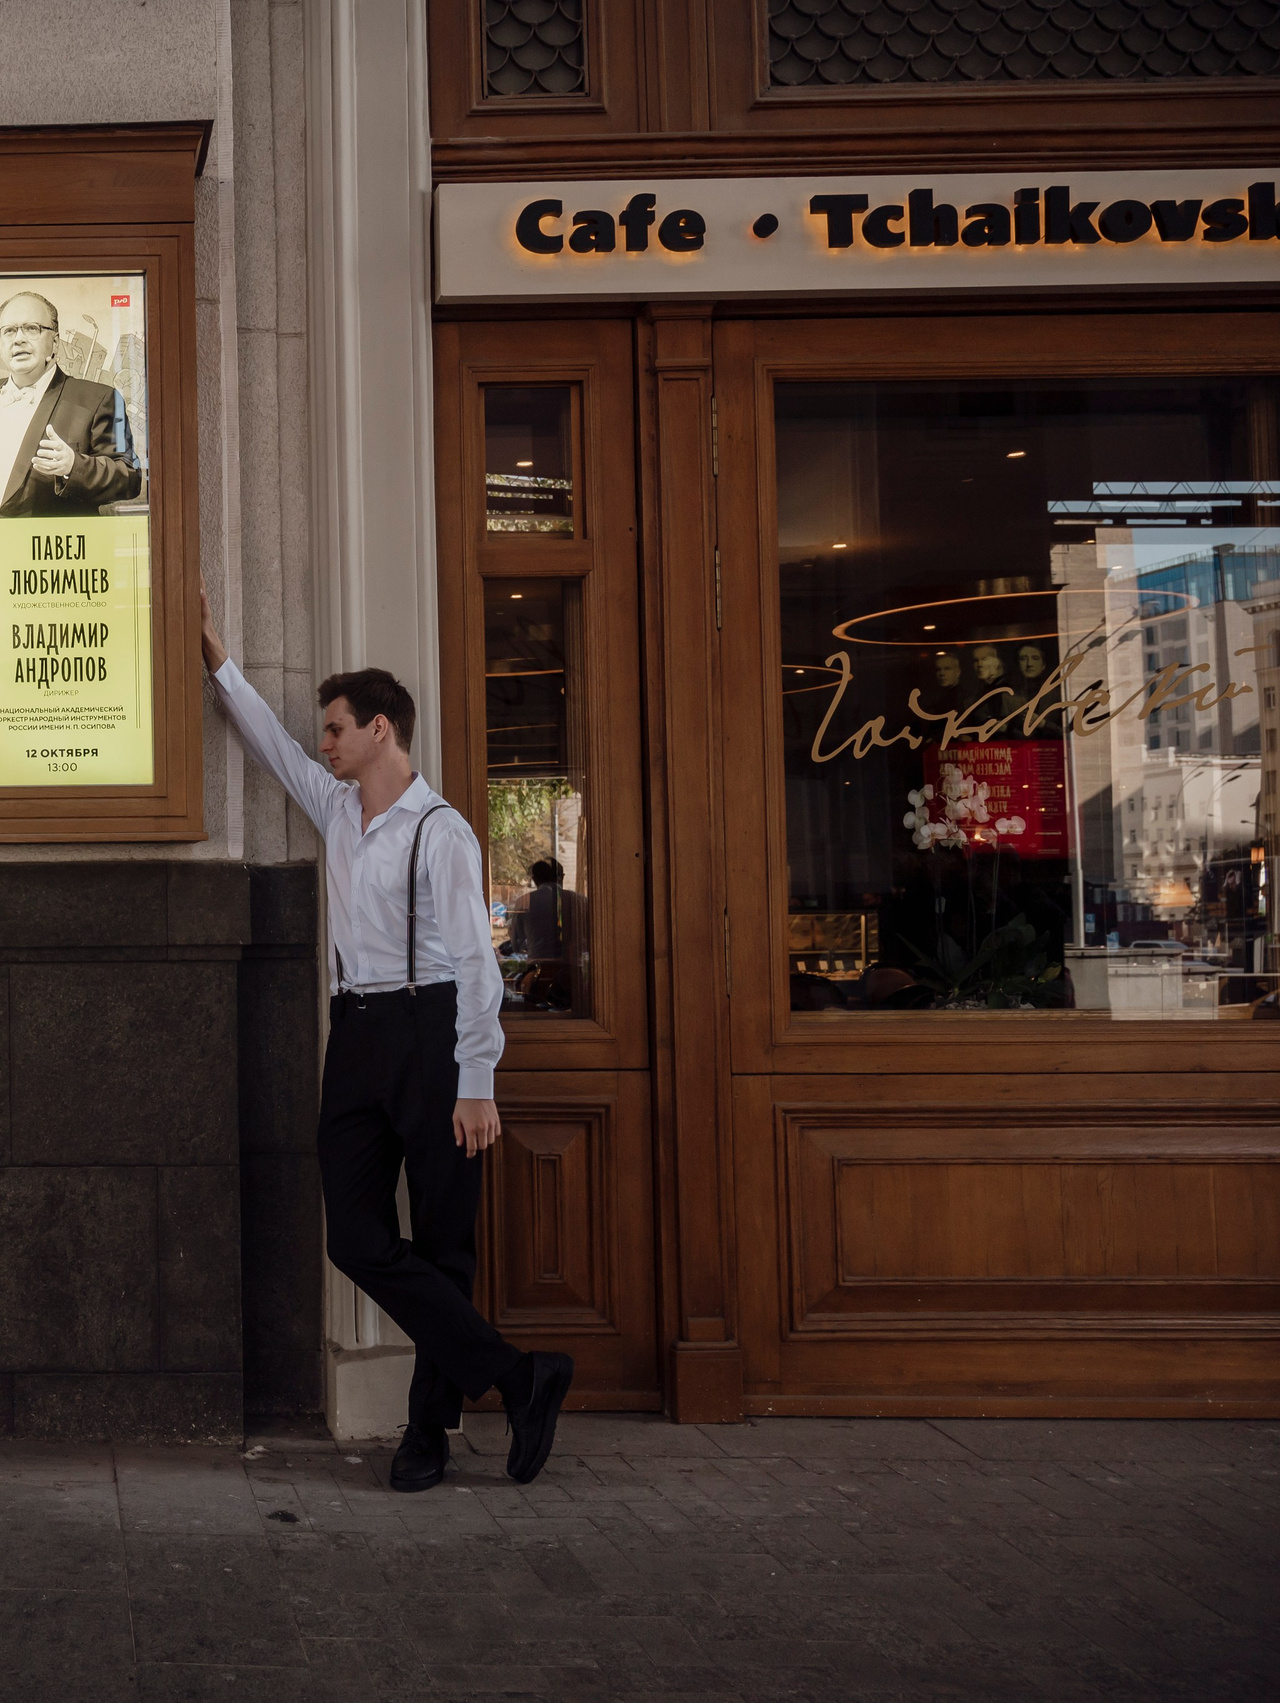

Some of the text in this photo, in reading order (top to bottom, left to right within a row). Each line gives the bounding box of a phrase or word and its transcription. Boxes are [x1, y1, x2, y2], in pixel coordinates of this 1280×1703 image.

[515, 193, 706, 254] Cafe
[32, 535, 86, 560] ПАВЕЛ
[9, 568, 109, 600] ЛЮБИМЦЕВ
[12, 623, 109, 655] ВЛАДИМИР
[15, 656, 107, 689] АНДРОПОВ
[43, 689, 79, 697] ДИРИЖЕР
[0, 705, 124, 714] НАЦИОНАЛЬНЫЙ АКАДЕМИЧЕСКИЙ
[29, 714, 70, 722] НАРОДНЫЙ
[26, 748, 98, 758] 12 ОКТЯБРЯ
[47, 762, 78, 772] 13:00
